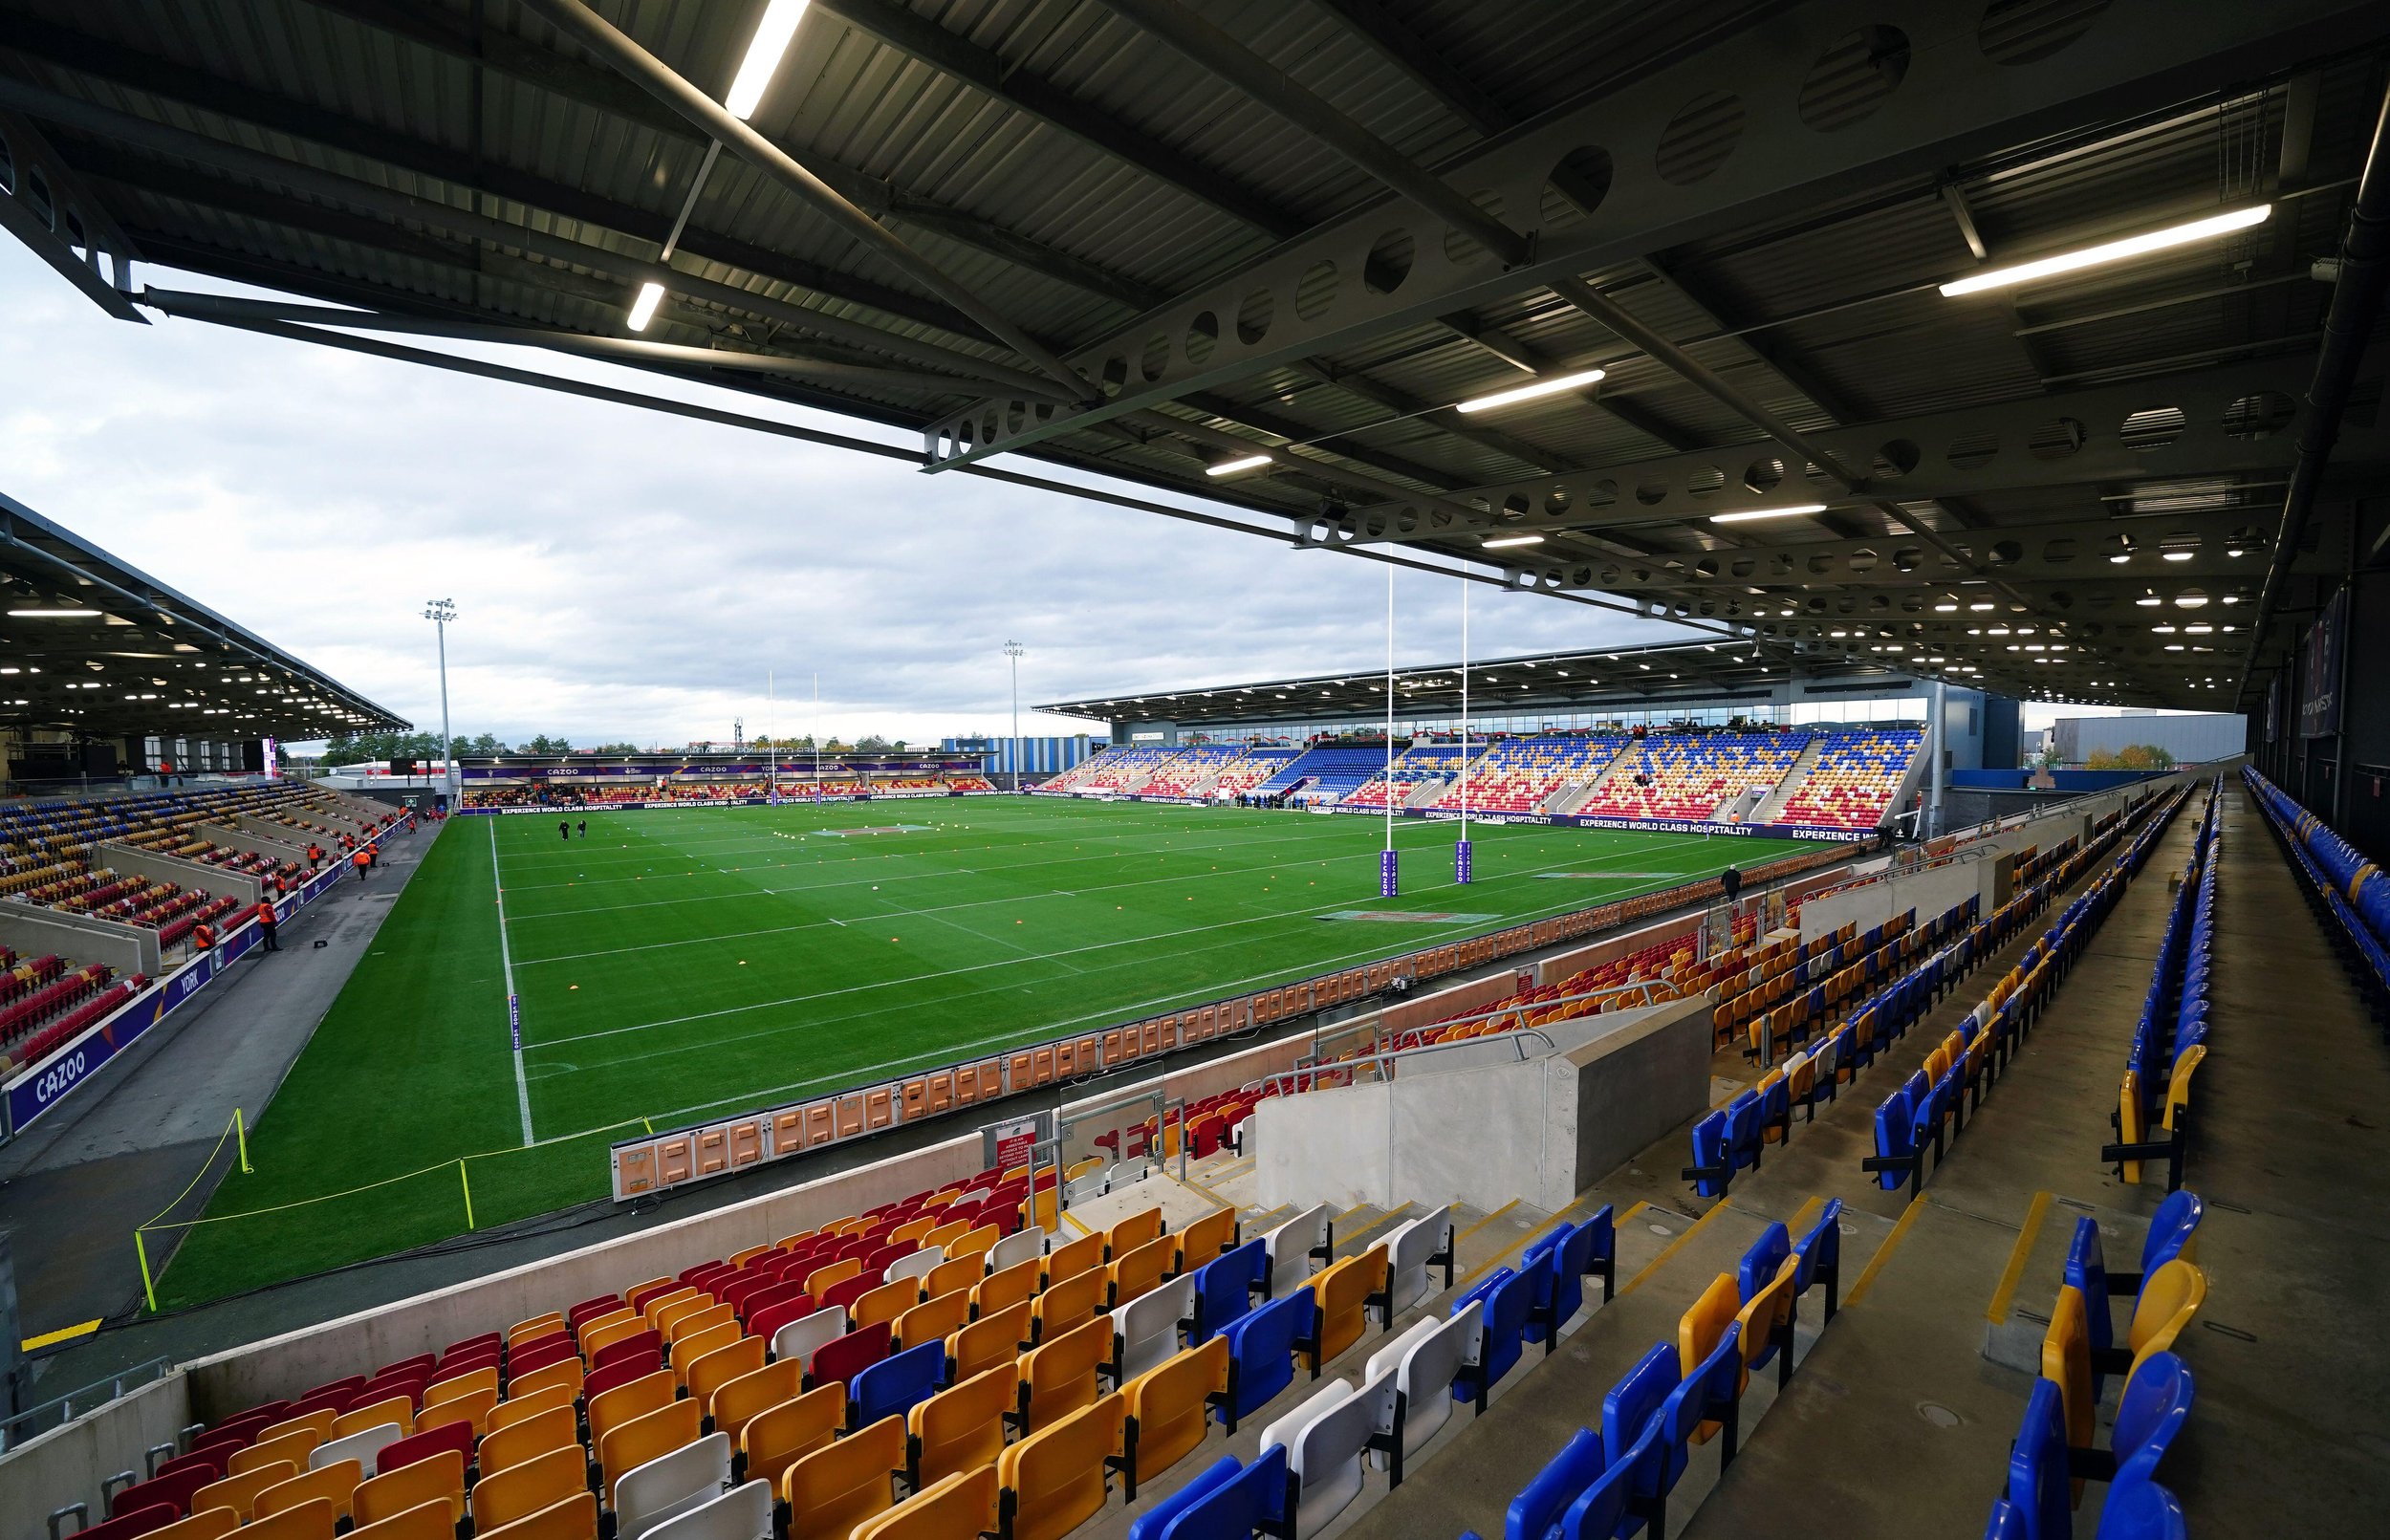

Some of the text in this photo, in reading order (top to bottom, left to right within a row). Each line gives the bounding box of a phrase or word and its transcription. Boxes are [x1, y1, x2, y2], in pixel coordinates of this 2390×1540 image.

[1425, 811, 1461, 819] EXPERIENCE
[1506, 814, 1553, 825] HOSPITALITY
[1579, 819, 1752, 835] EXPERIENCE WORLD CLASS HOSPITALITY
[1792, 829, 1860, 841] EXPERIENCE
[181, 968, 199, 995] YORK
[36, 1052, 85, 1103] CAZOO
